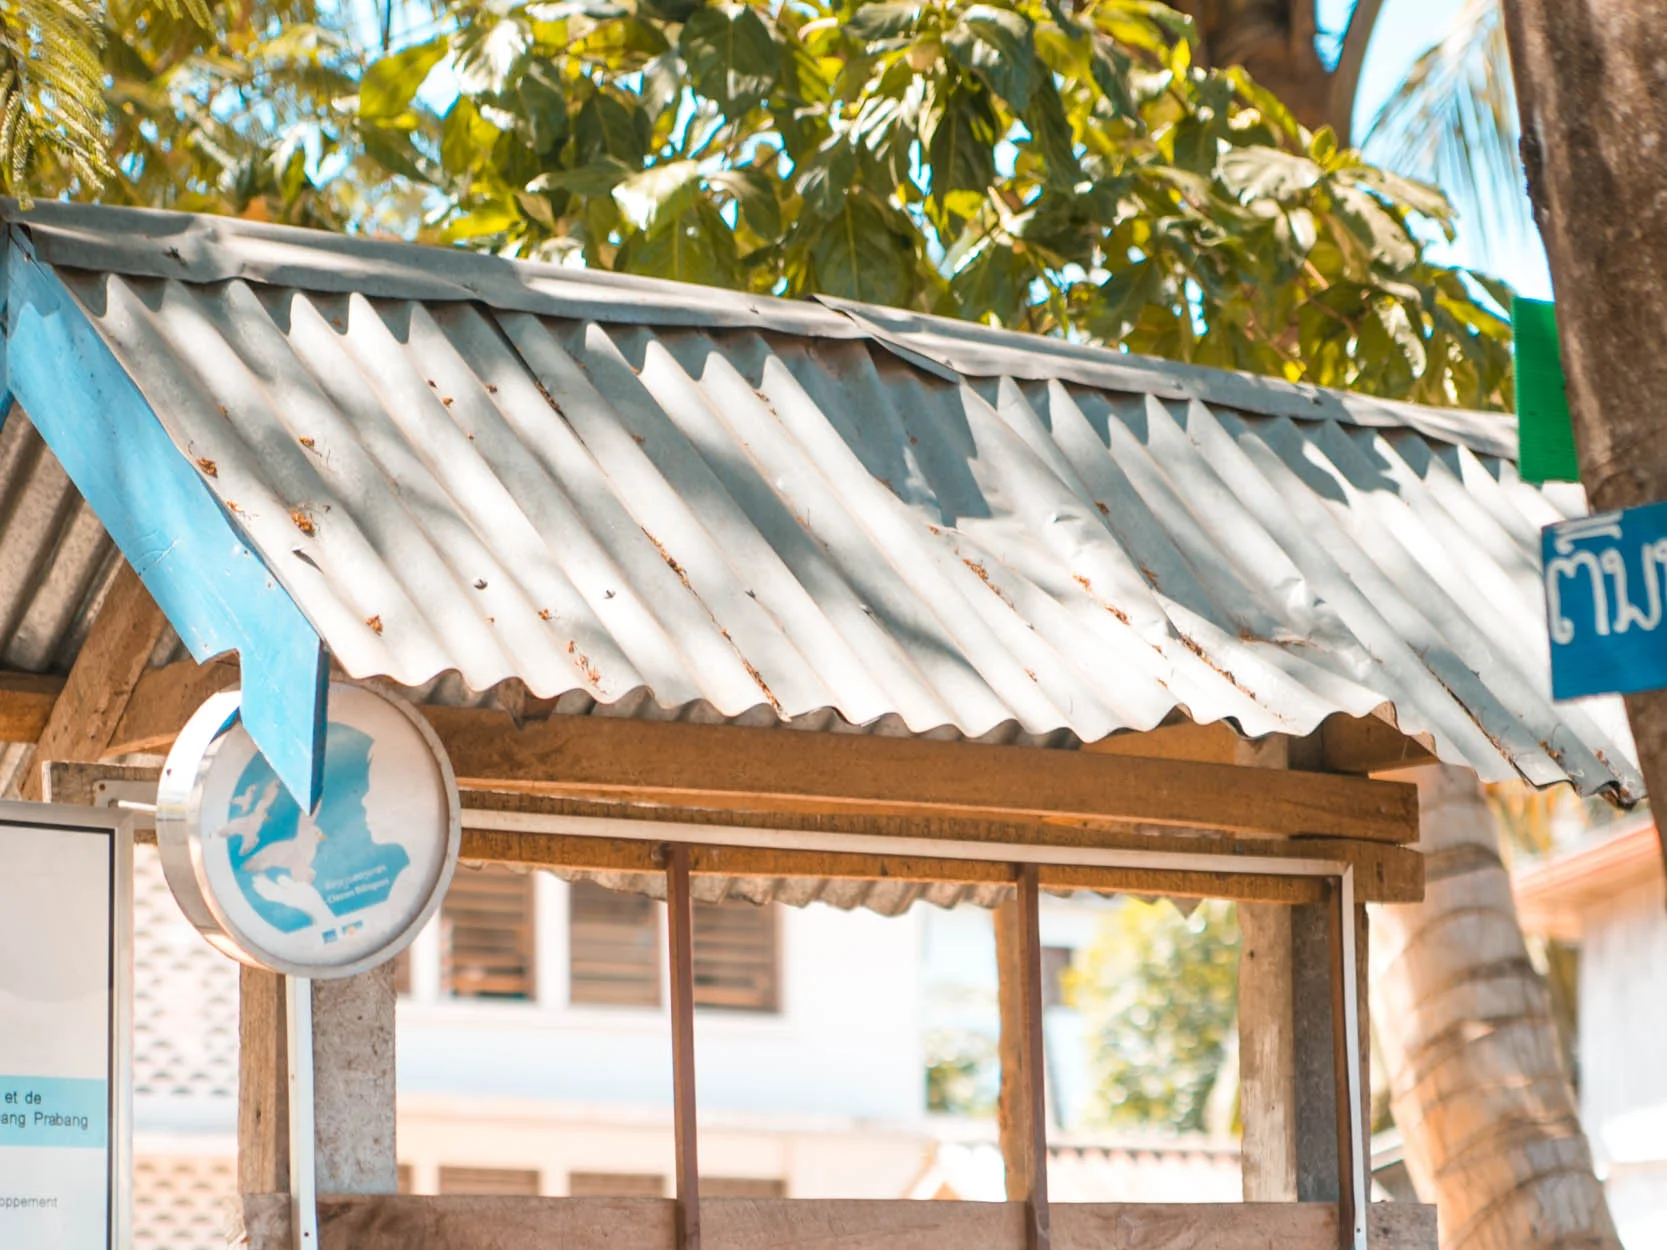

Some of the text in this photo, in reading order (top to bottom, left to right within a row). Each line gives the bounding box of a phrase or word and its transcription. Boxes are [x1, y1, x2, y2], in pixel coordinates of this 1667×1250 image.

[5, 1090, 42, 1105] et de
[34, 1111, 89, 1131] Prabang
